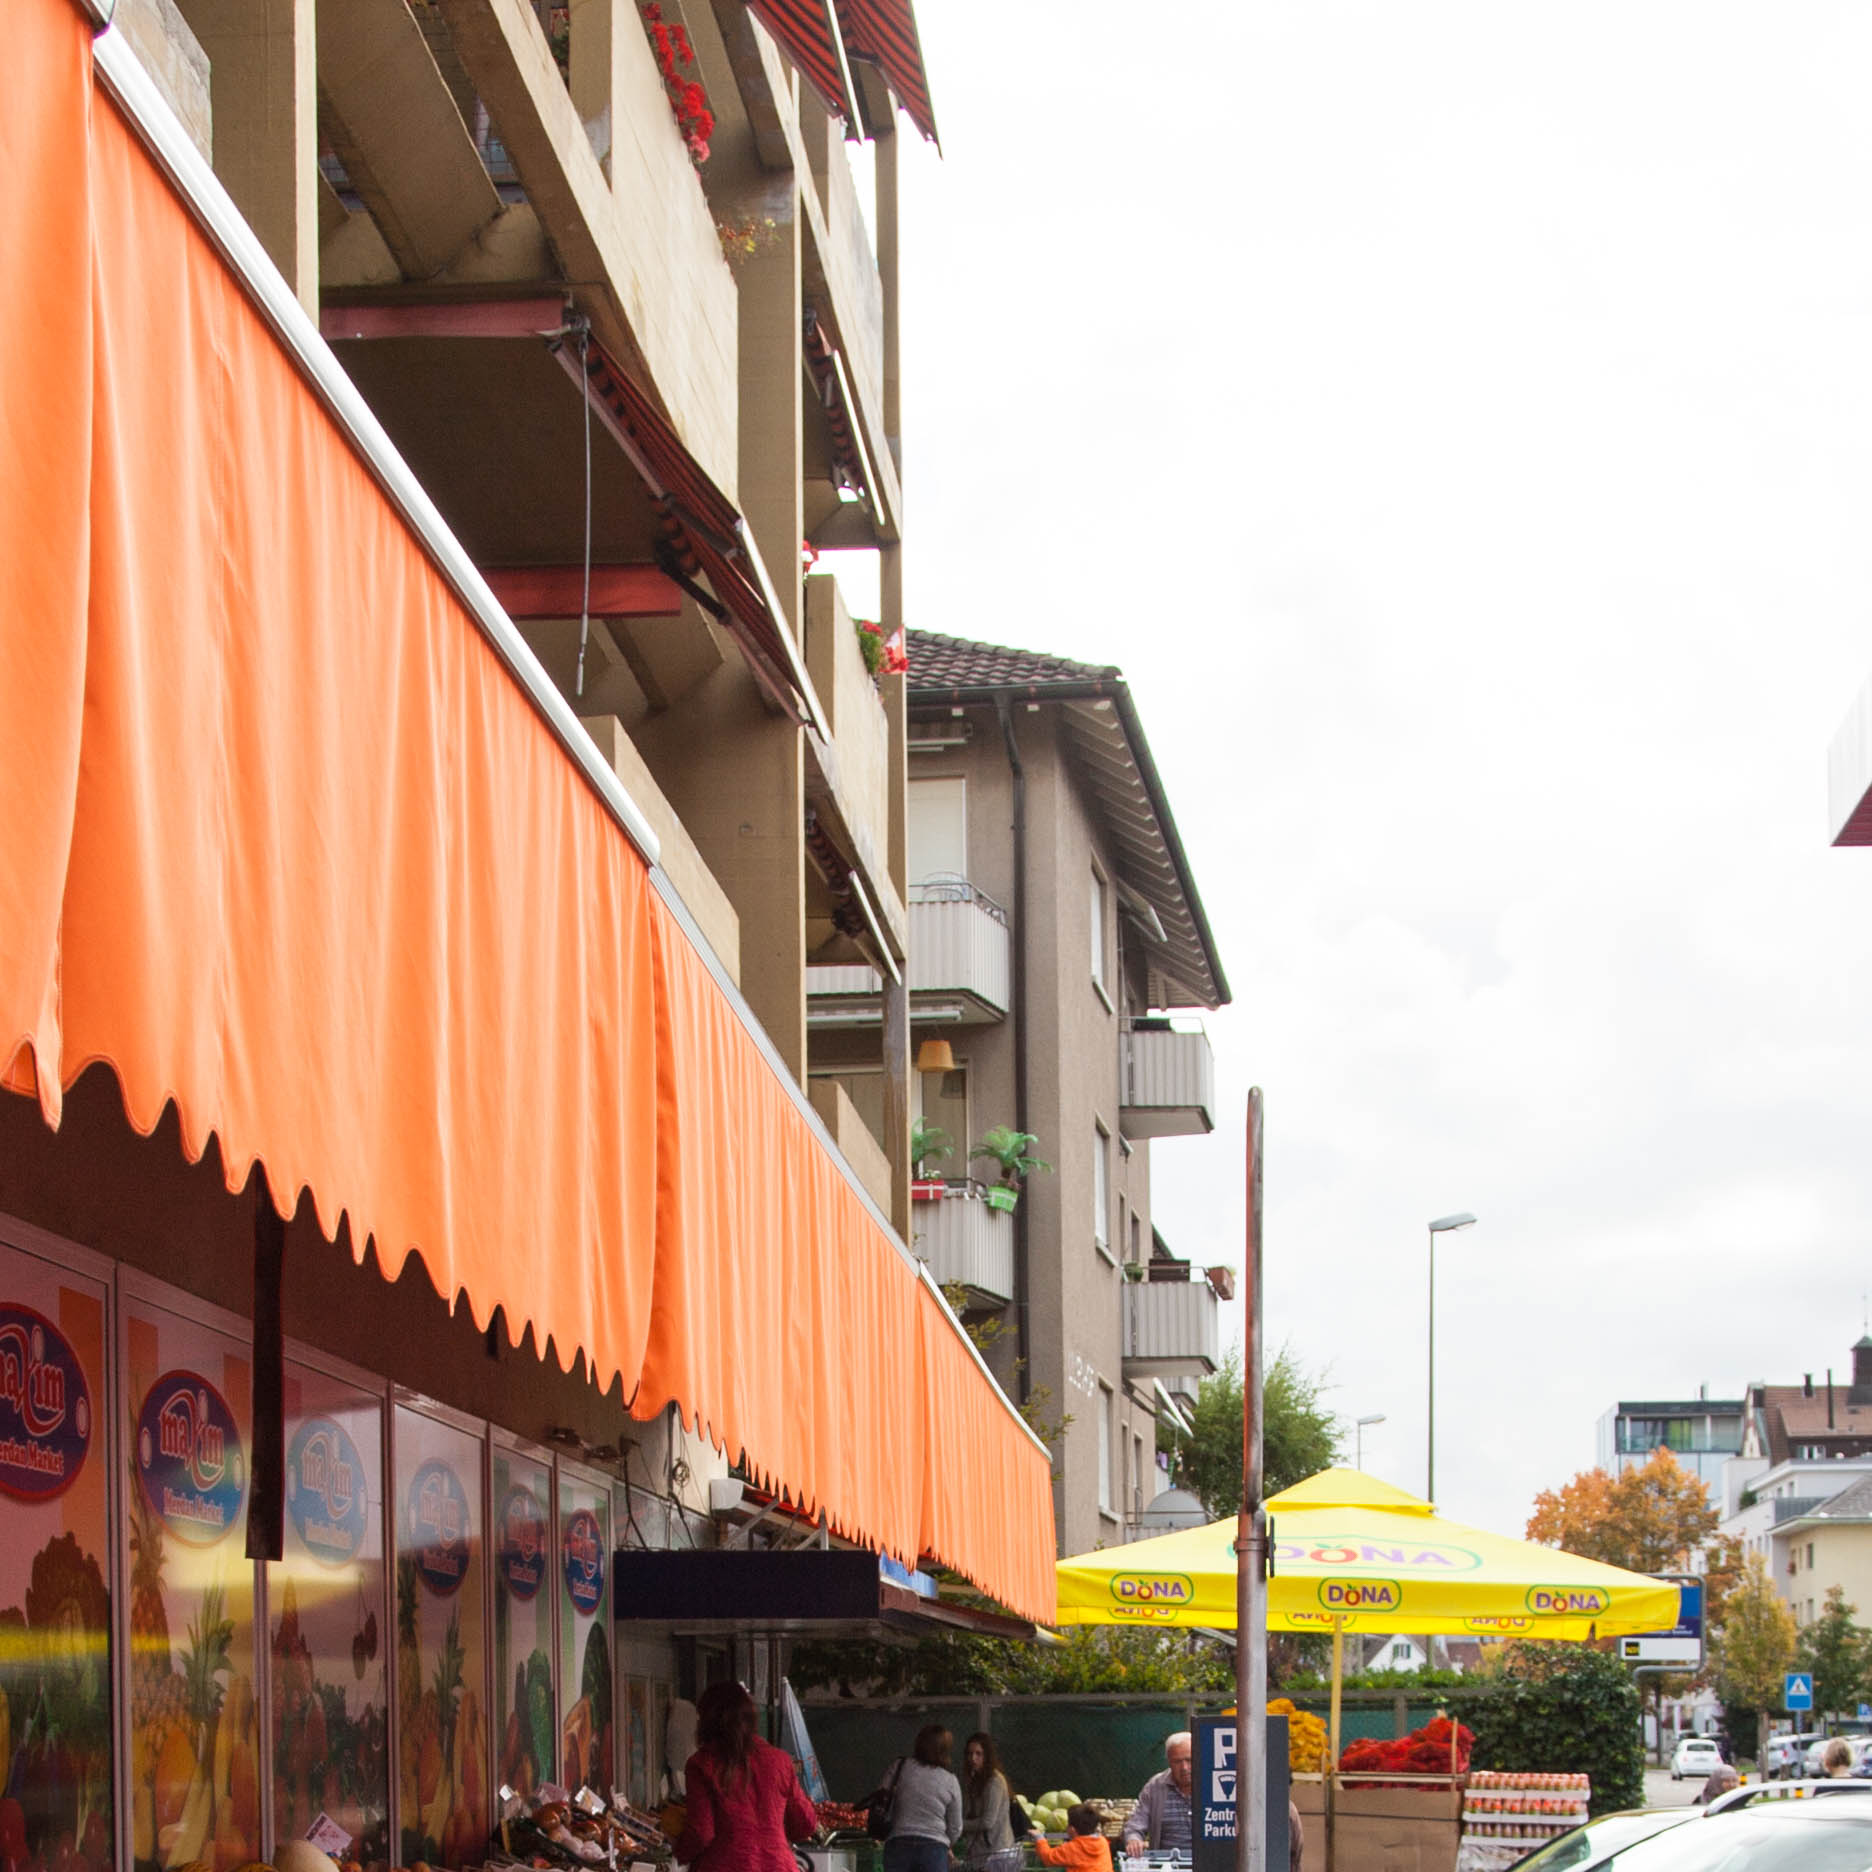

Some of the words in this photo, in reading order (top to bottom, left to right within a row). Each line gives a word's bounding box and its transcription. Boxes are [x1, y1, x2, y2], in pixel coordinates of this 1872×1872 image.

[28, 1443, 64, 1475] Market
[1120, 1580, 1185, 1600] DONA
[1328, 1585, 1392, 1606] DONA
[1536, 1592, 1600, 1612] DONA
[1205, 1807, 1236, 1821] Zentr
[1205, 1823, 1237, 1837] Parku
